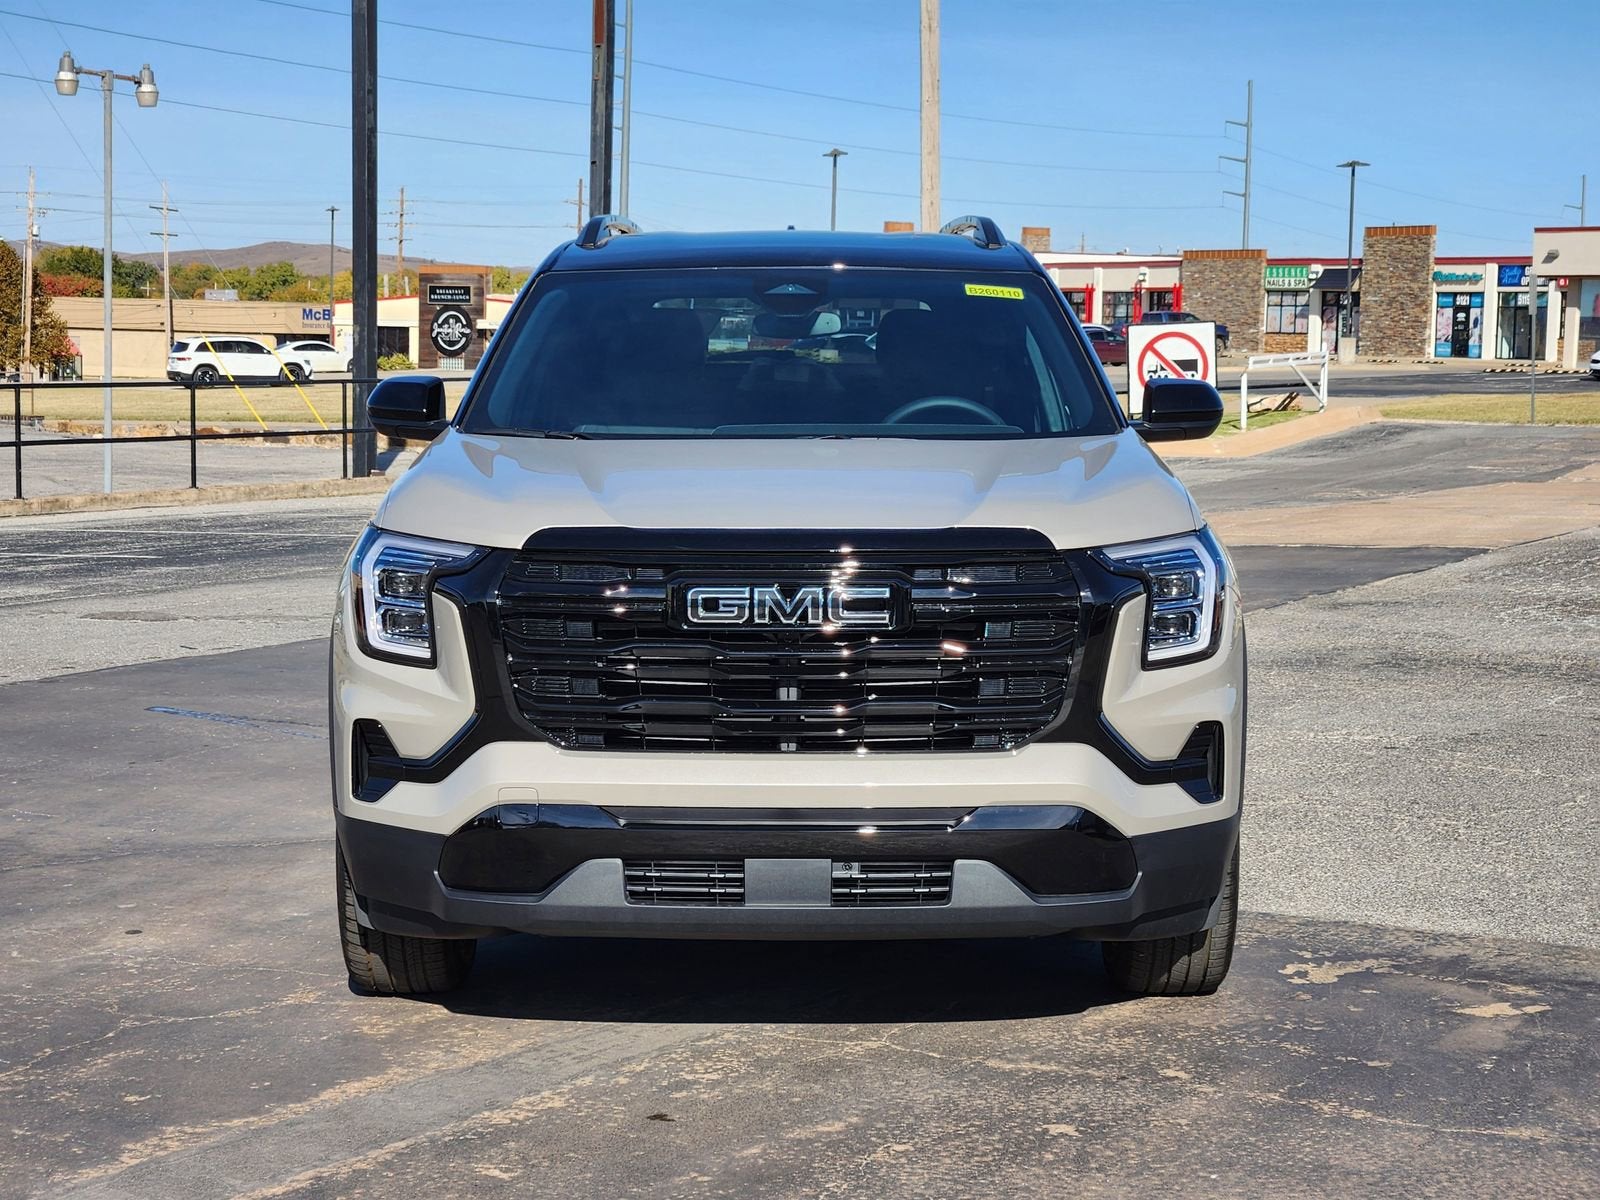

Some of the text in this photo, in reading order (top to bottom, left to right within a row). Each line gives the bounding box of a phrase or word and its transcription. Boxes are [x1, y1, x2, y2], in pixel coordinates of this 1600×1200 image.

[1266, 267, 1308, 277] ESSENCE
[1267, 280, 1307, 288] NAILS & SPA
[968, 287, 1021, 298] B260110
[1456, 294, 1470, 306] 5121
[687, 586, 890, 624] GMC
